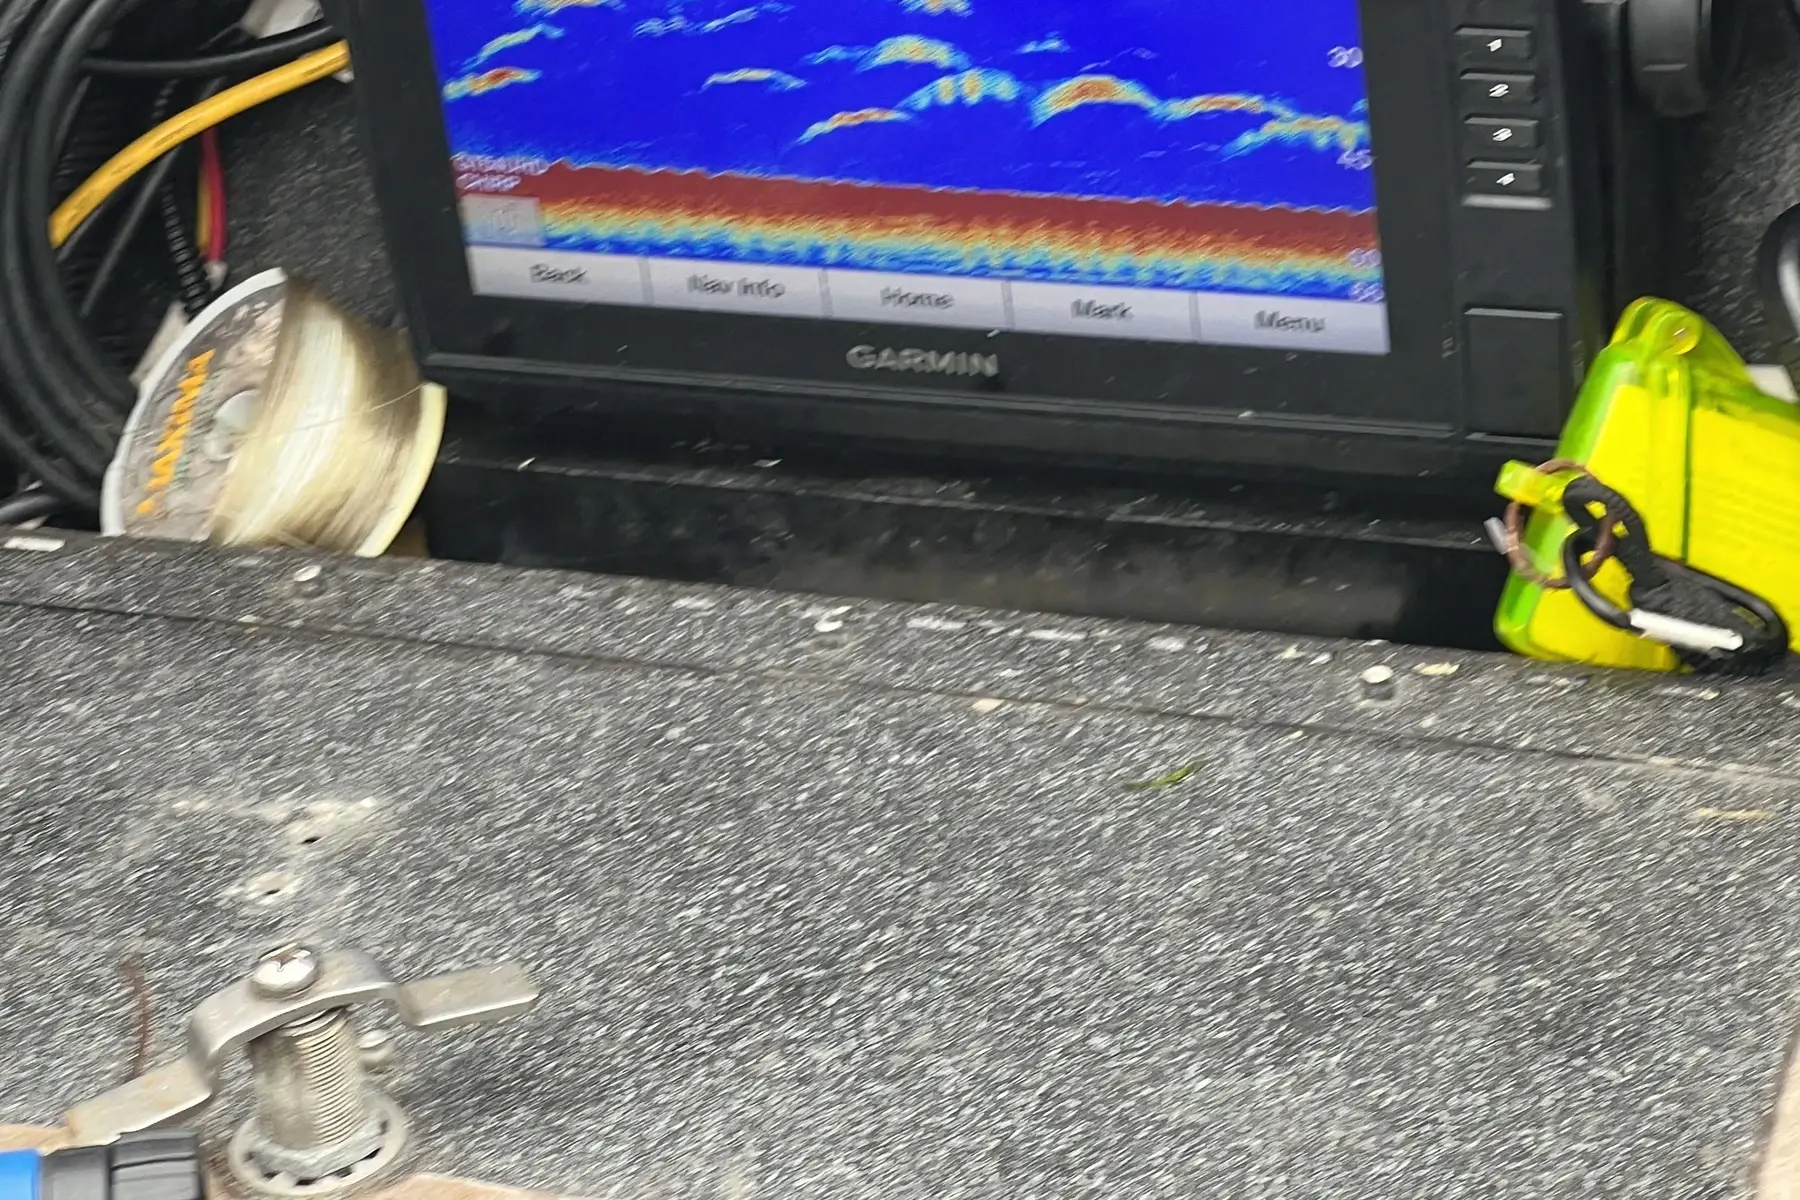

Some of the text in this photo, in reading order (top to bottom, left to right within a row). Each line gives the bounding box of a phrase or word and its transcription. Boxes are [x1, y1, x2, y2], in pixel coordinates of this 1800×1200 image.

[1327, 46, 1363, 68] 30
[1336, 149, 1375, 171] 45
[529, 262, 589, 285] Back
[686, 273, 734, 296] Nav
[879, 285, 955, 310] Home
[1070, 298, 1135, 321] Mark
[1253, 309, 1327, 333] Menu
[846, 343, 999, 377] GARMIN
